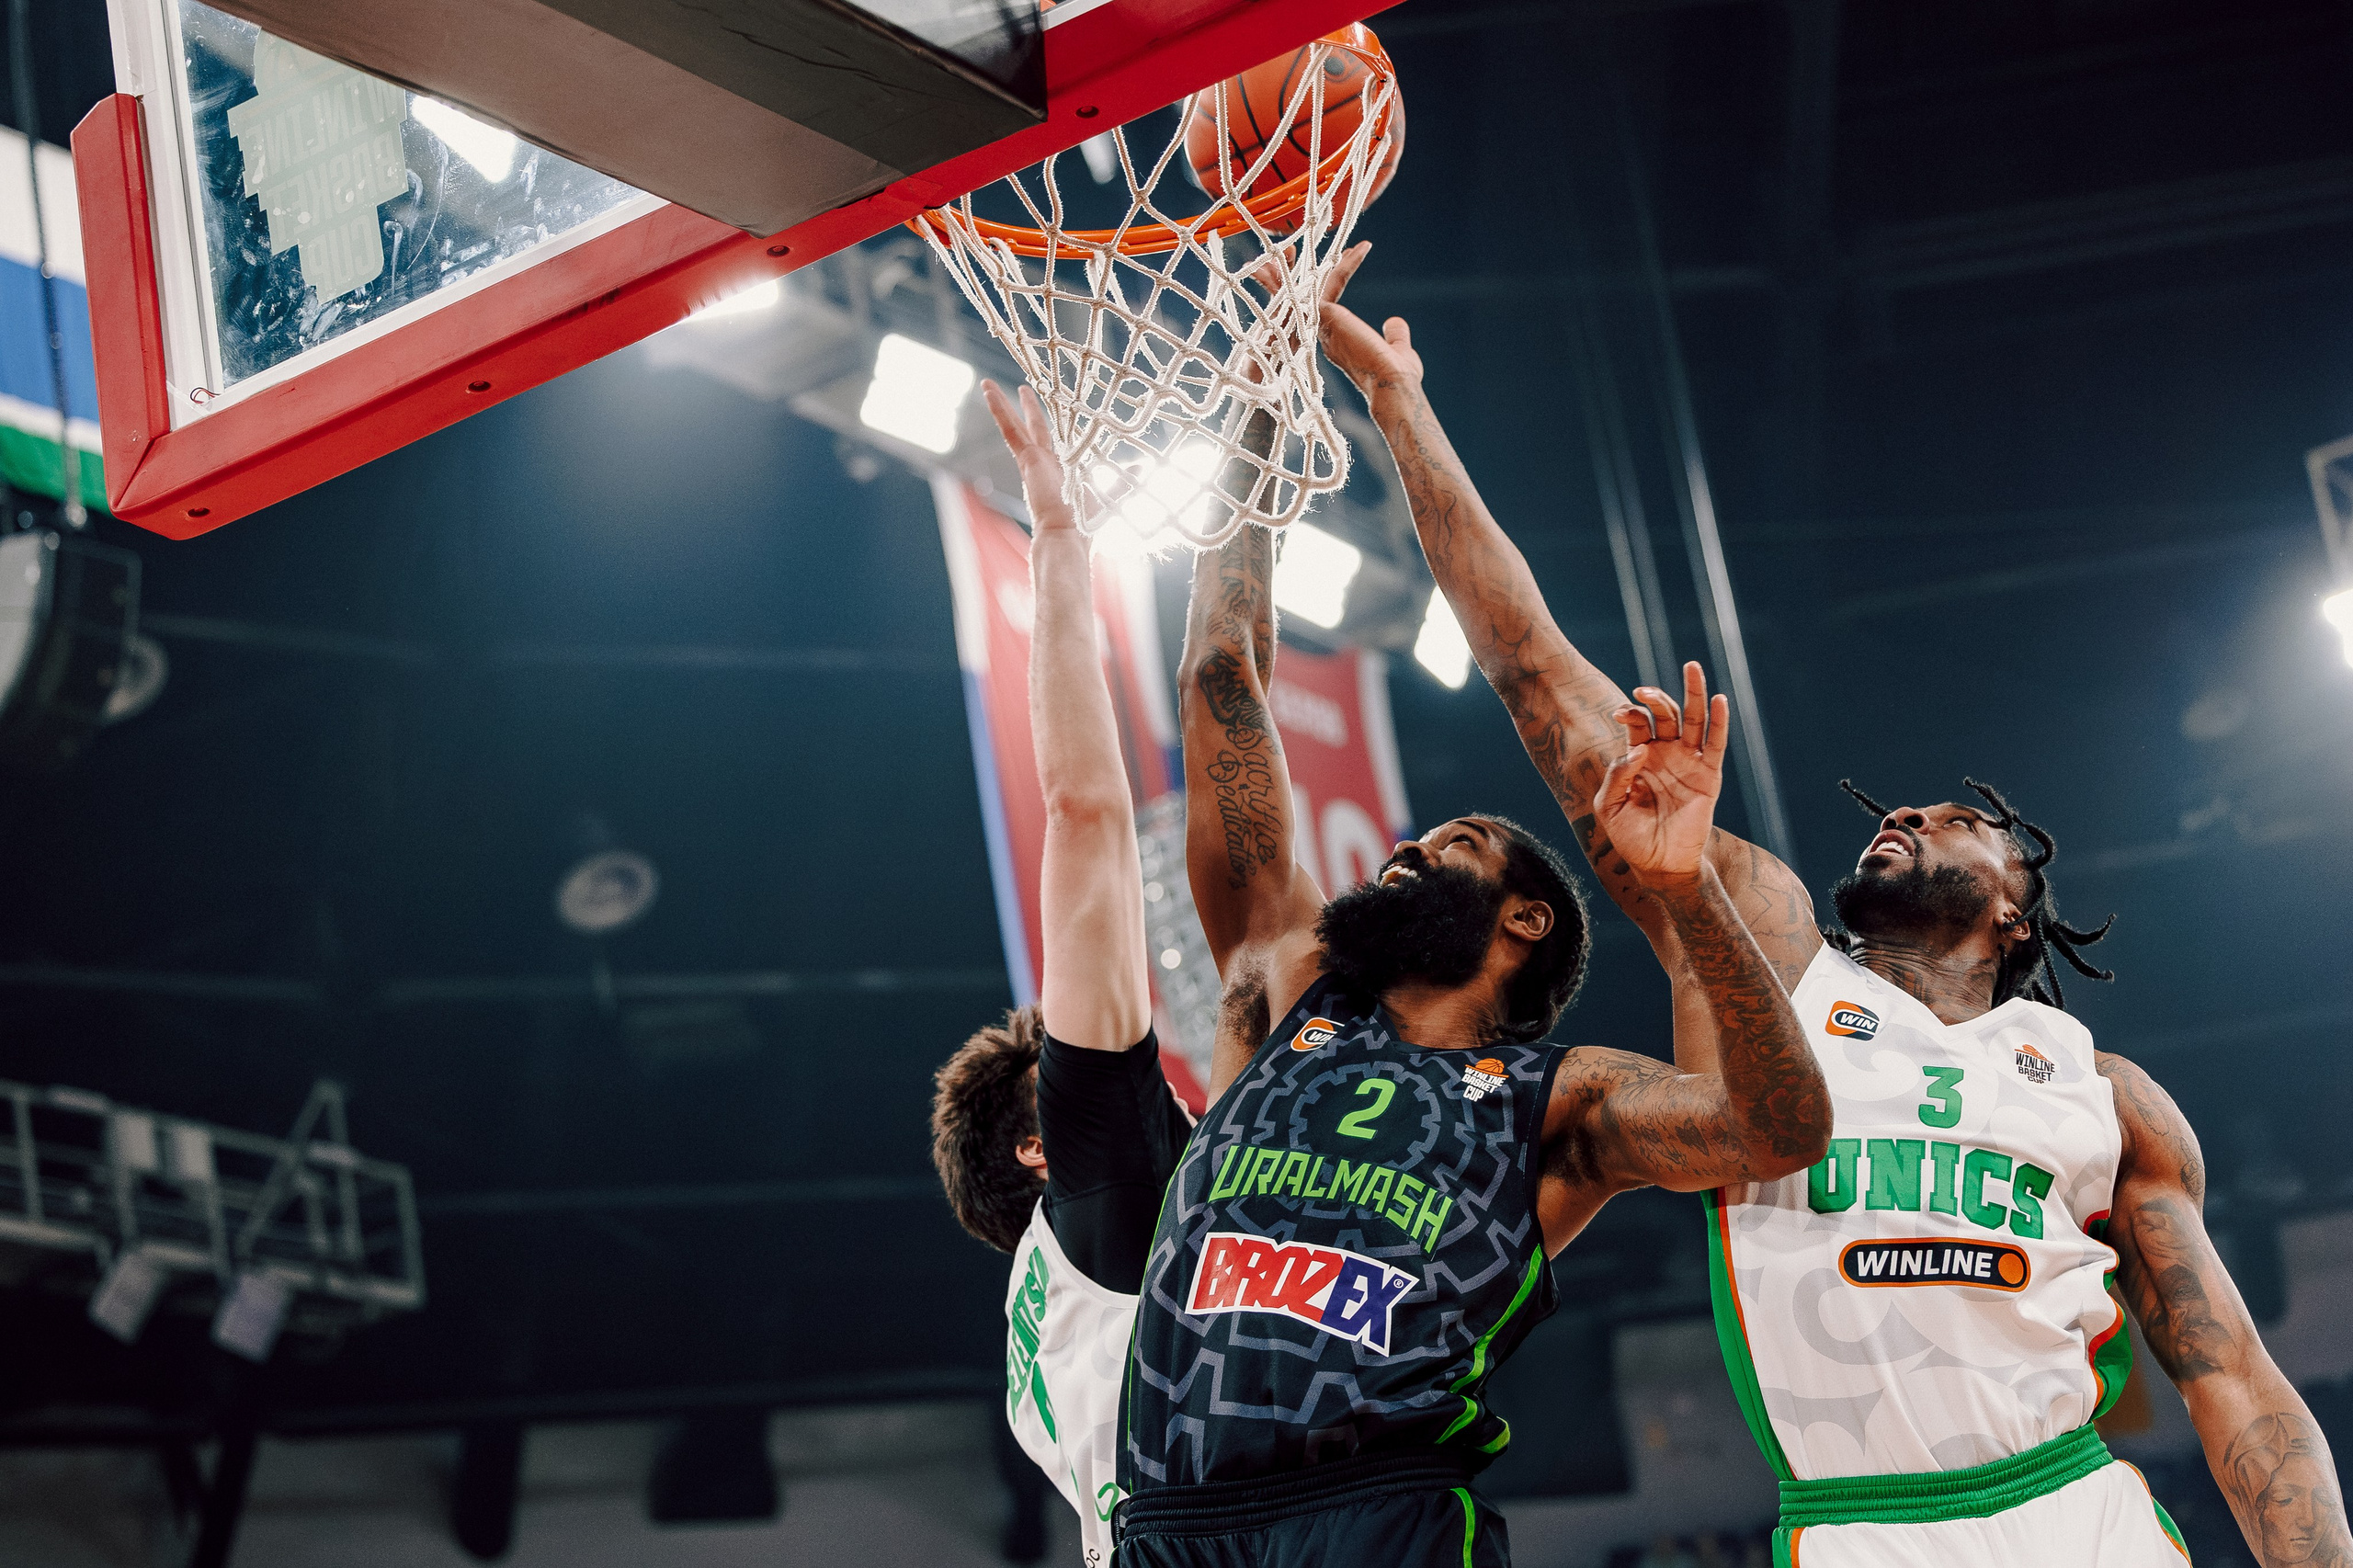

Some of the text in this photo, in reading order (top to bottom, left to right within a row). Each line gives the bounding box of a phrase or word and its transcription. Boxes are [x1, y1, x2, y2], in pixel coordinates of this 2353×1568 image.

[1839, 1013, 1878, 1030] WIN
[2016, 1051, 2056, 1074] WINLINE
[2018, 1066, 2052, 1082] BASKET
[1461, 1073, 1498, 1094] BASKET
[1464, 1066, 1506, 1087] WINLINE
[1462, 1085, 1485, 1102] CUP
[1918, 1065, 1964, 1130] 3
[1336, 1077, 1396, 1140] 2
[1208, 1145, 1454, 1254] URALMASH
[1807, 1138, 2055, 1241] UNICS
[1858, 1250, 1994, 1278] WINLINE
